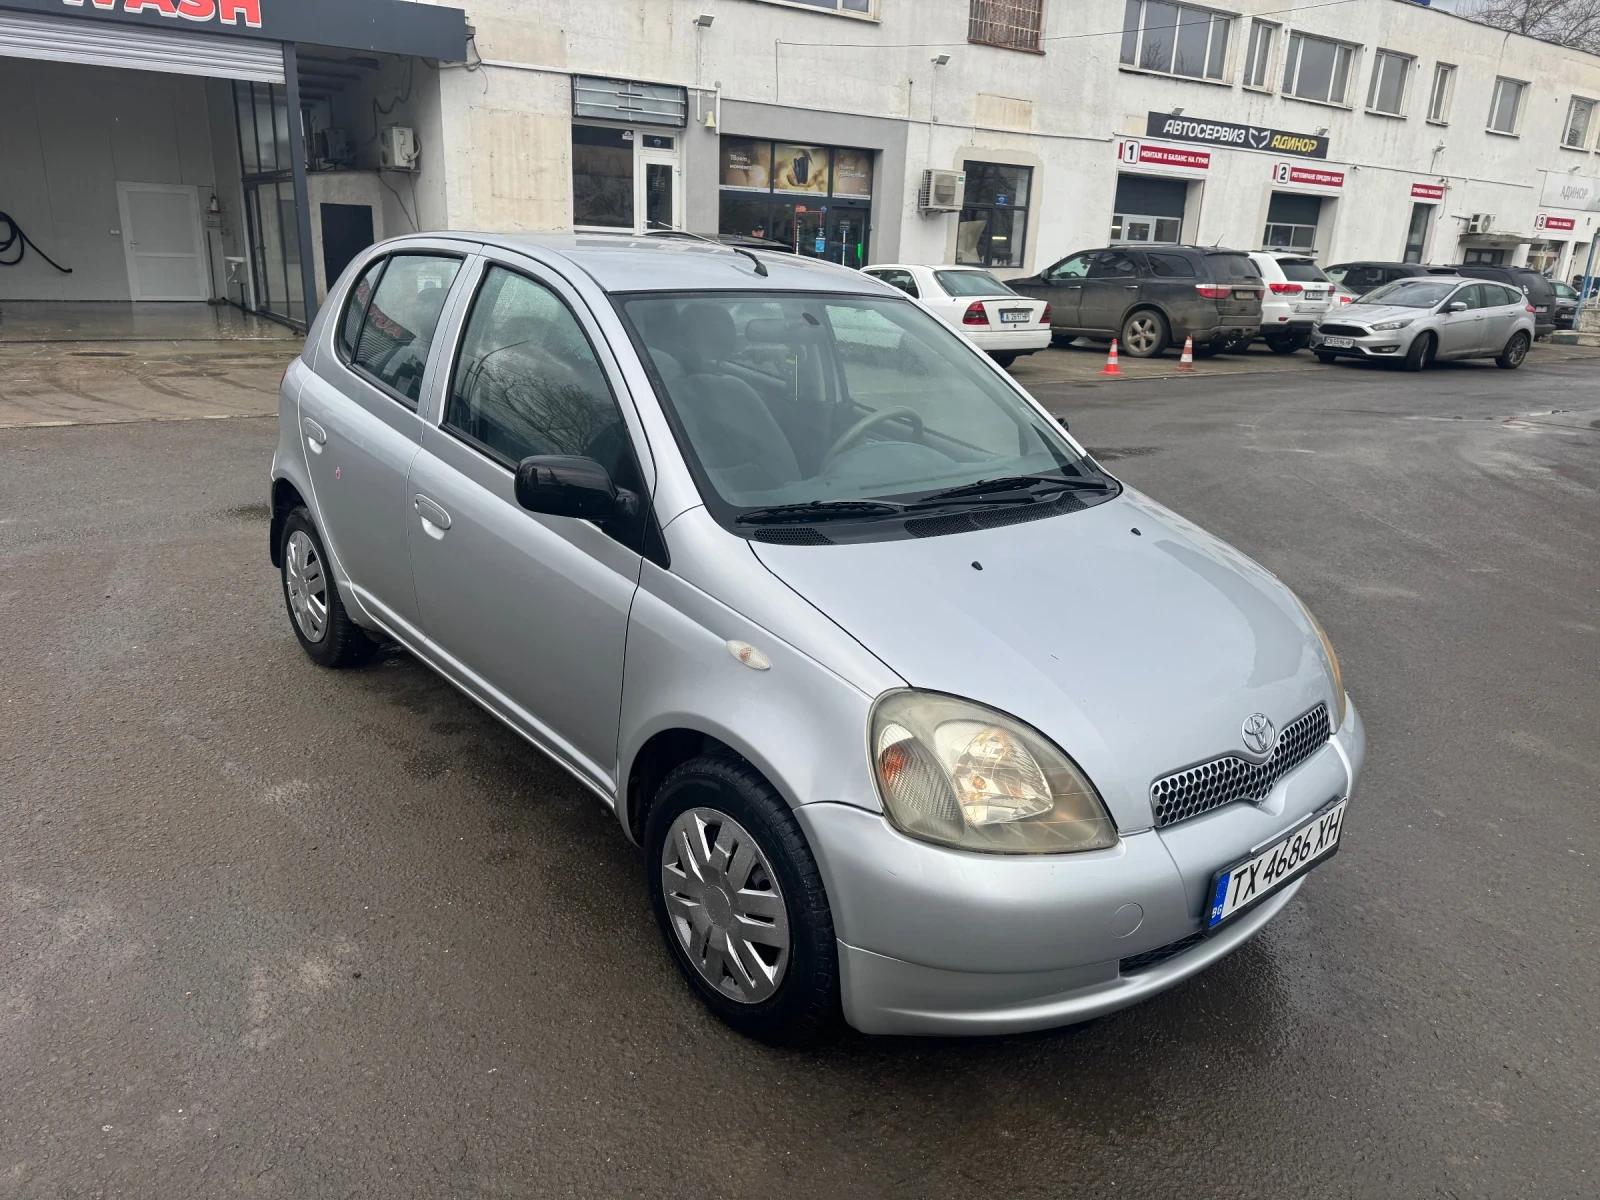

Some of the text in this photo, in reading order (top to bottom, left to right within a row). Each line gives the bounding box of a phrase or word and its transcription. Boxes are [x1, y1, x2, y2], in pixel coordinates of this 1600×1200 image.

[62, 0, 262, 28] ASH
[1163, 119, 1318, 152] АВТОСЕРВИЗ АДИНОР
[1128, 145, 1135, 160] 1
[1141, 150, 1163, 159] МОНТАЖ
[1168, 153, 1187, 162] БАЛАНС
[1280, 166, 1287, 180] 2
[1560, 185, 1589, 199] АДИНОР
[1539, 217, 1544, 227] 3
[1232, 807, 1342, 907] TX 4686 XH
[1211, 904, 1223, 918] BG
